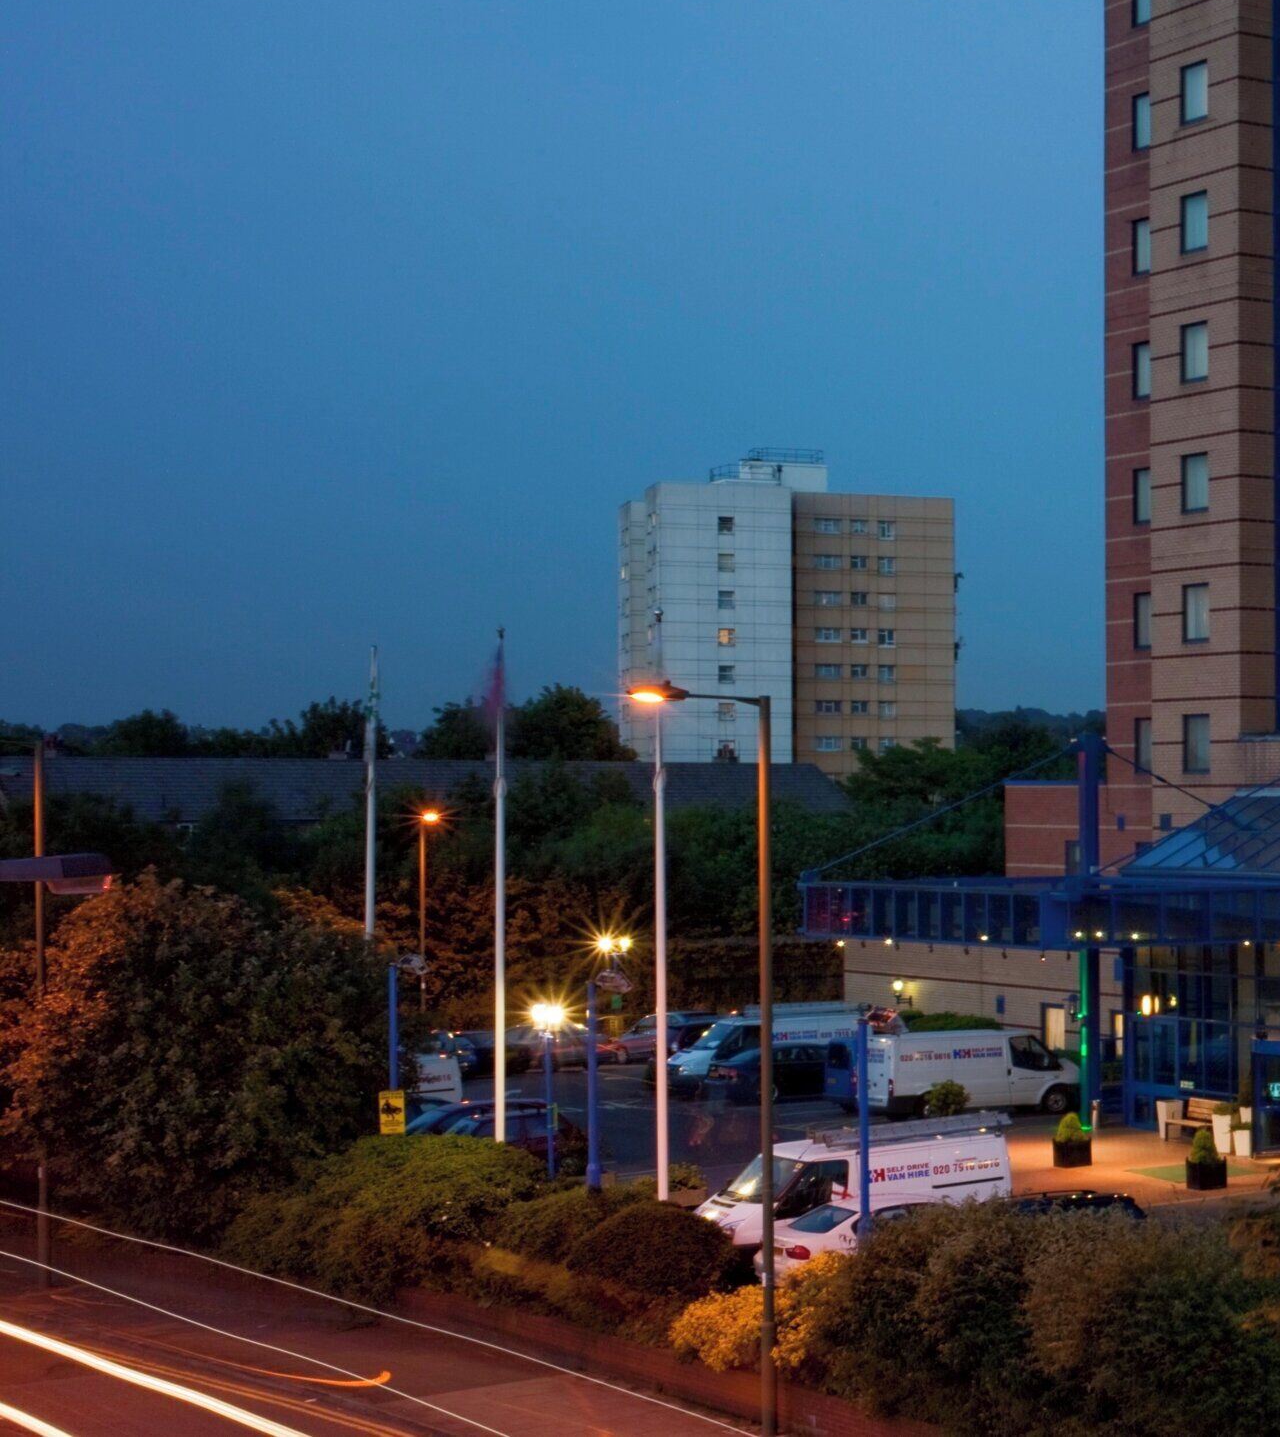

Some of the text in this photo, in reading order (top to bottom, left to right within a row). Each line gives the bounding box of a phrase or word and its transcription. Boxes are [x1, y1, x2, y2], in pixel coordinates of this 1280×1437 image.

[886, 1162, 930, 1174] SELF DRIVE
[932, 1164, 951, 1176] 020
[886, 1169, 931, 1181] VAN HIRE
